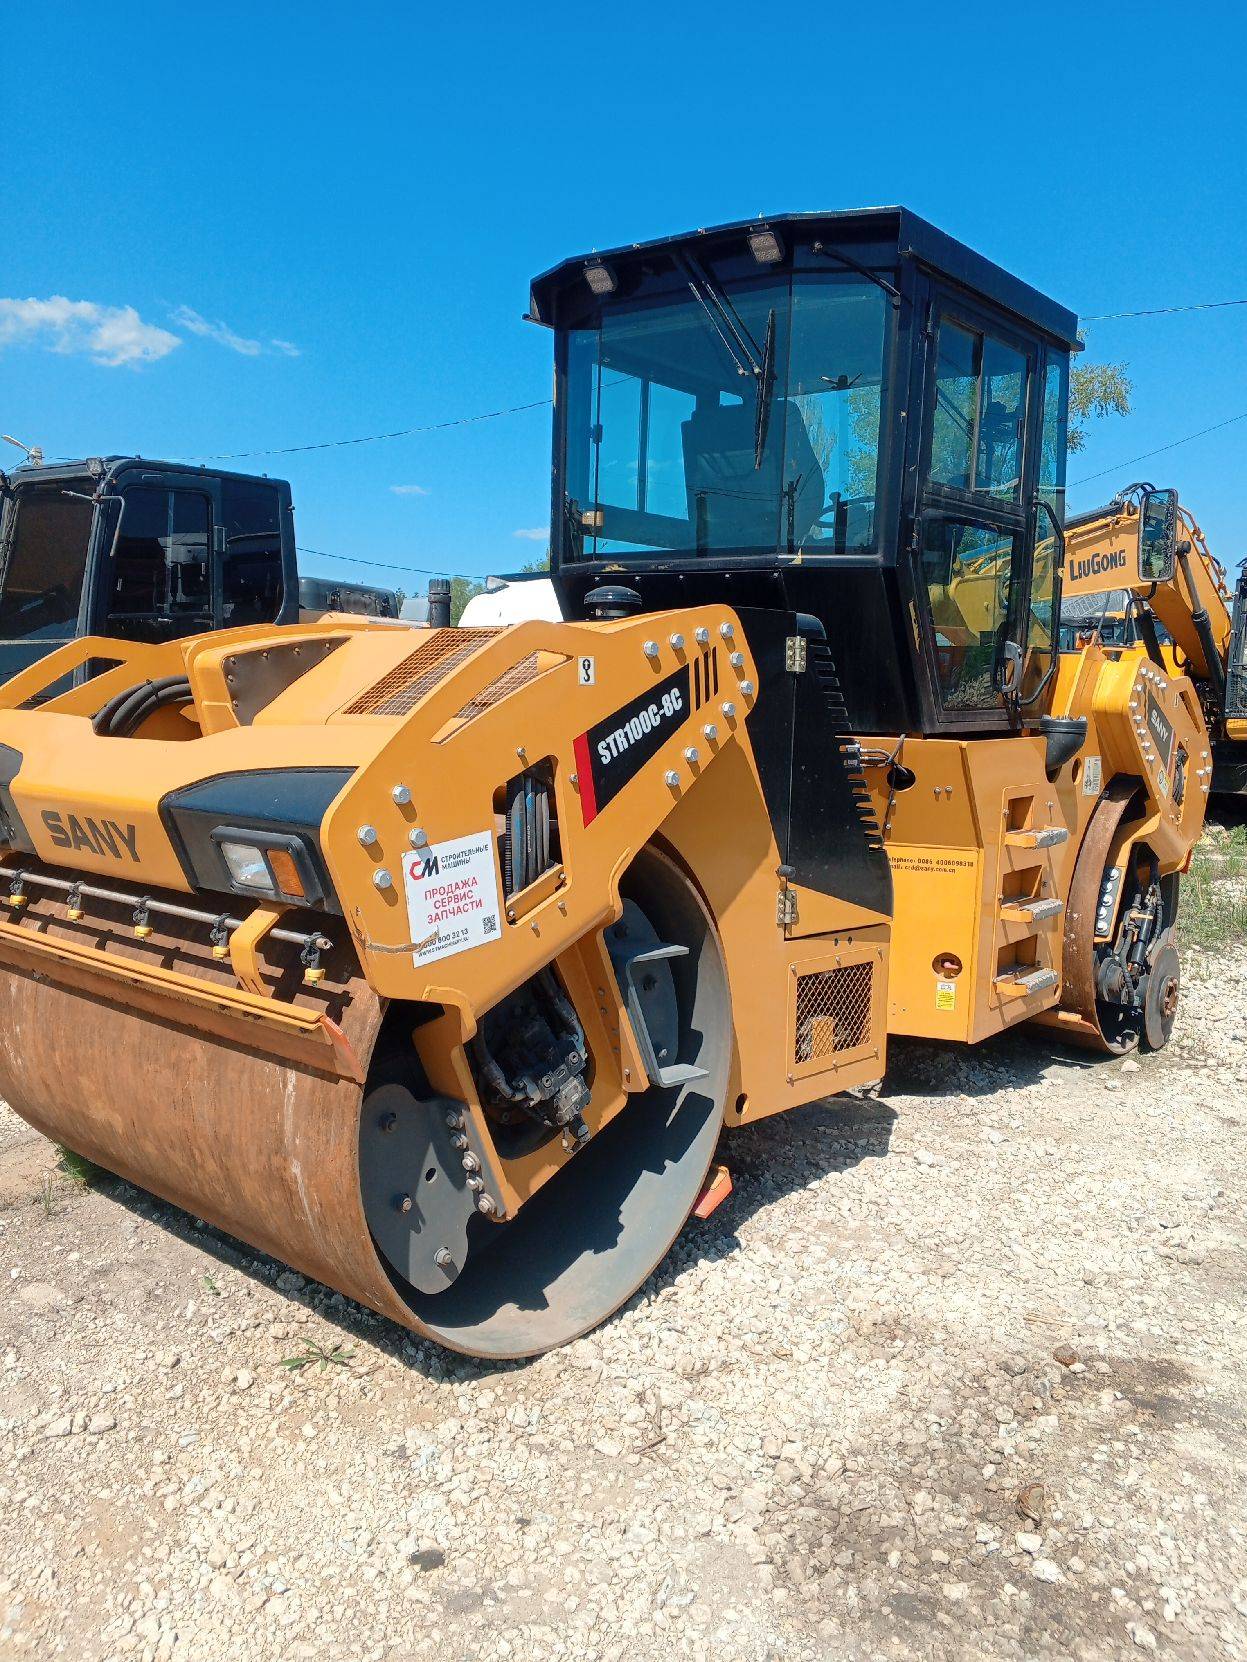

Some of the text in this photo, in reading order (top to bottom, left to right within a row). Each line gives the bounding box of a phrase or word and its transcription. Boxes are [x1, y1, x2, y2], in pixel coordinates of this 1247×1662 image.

[598, 688, 683, 765] STR100C-8C
[1151, 709, 1168, 742] SANY
[40, 810, 141, 862] SANY
[441, 844, 489, 863] СТРОИТЕЛЬНЫЕ
[441, 857, 471, 871] МАШИНЫ
[424, 876, 478, 900] ПРОДАЖА
[433, 889, 474, 910] СЕРВИС
[427, 899, 483, 925] ЗАПЧАСТИ
[451, 930, 460, 939] 32
[460, 927, 469, 936] 13
